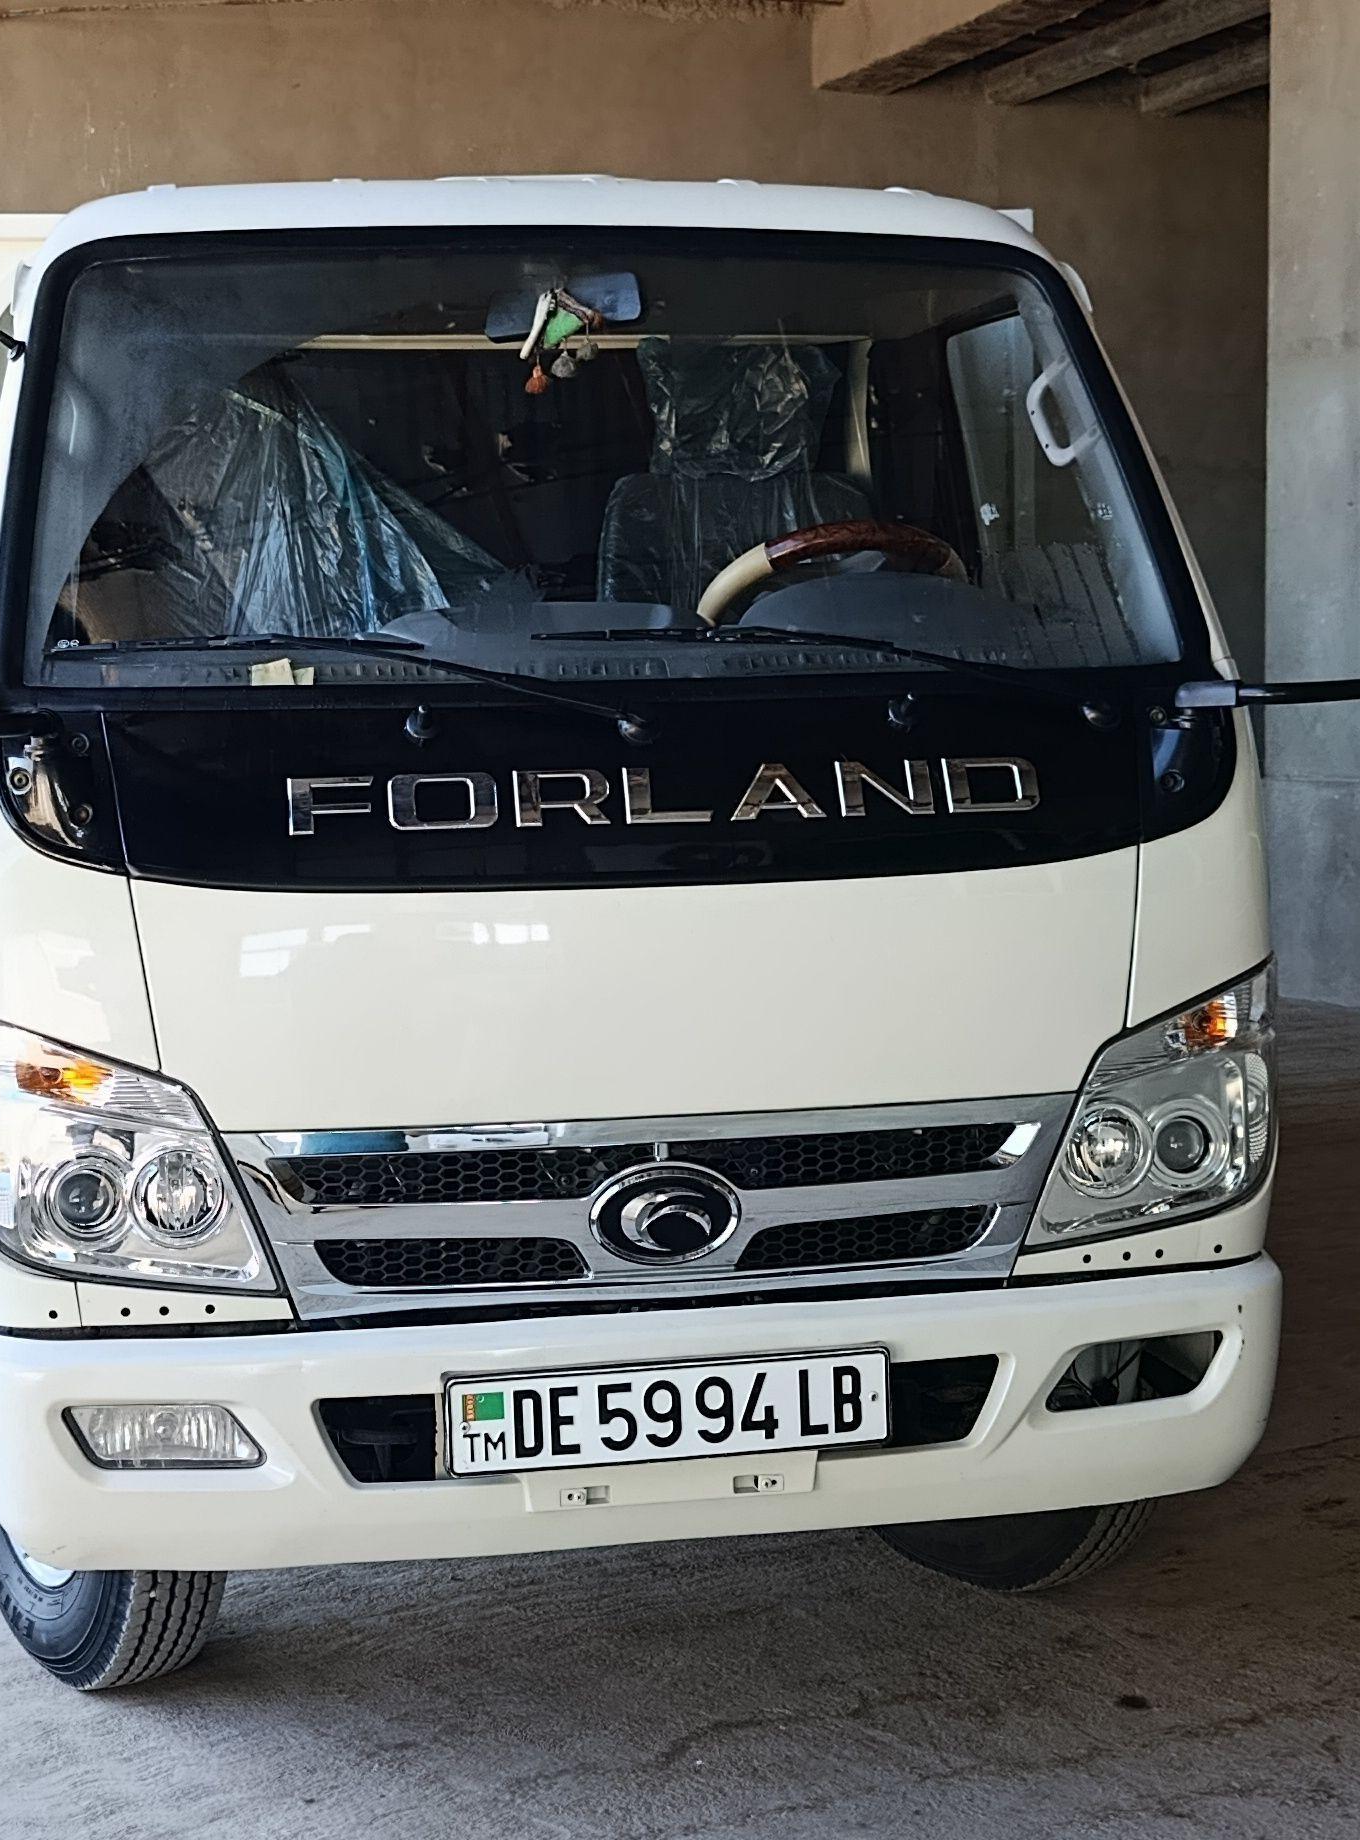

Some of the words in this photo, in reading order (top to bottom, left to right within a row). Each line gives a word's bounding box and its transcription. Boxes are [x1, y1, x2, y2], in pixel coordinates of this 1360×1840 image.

[288, 757, 1041, 836] FORLAND
[463, 1431, 508, 1463] TM
[513, 1387, 582, 1459] DE
[798, 1365, 863, 1438] LB
